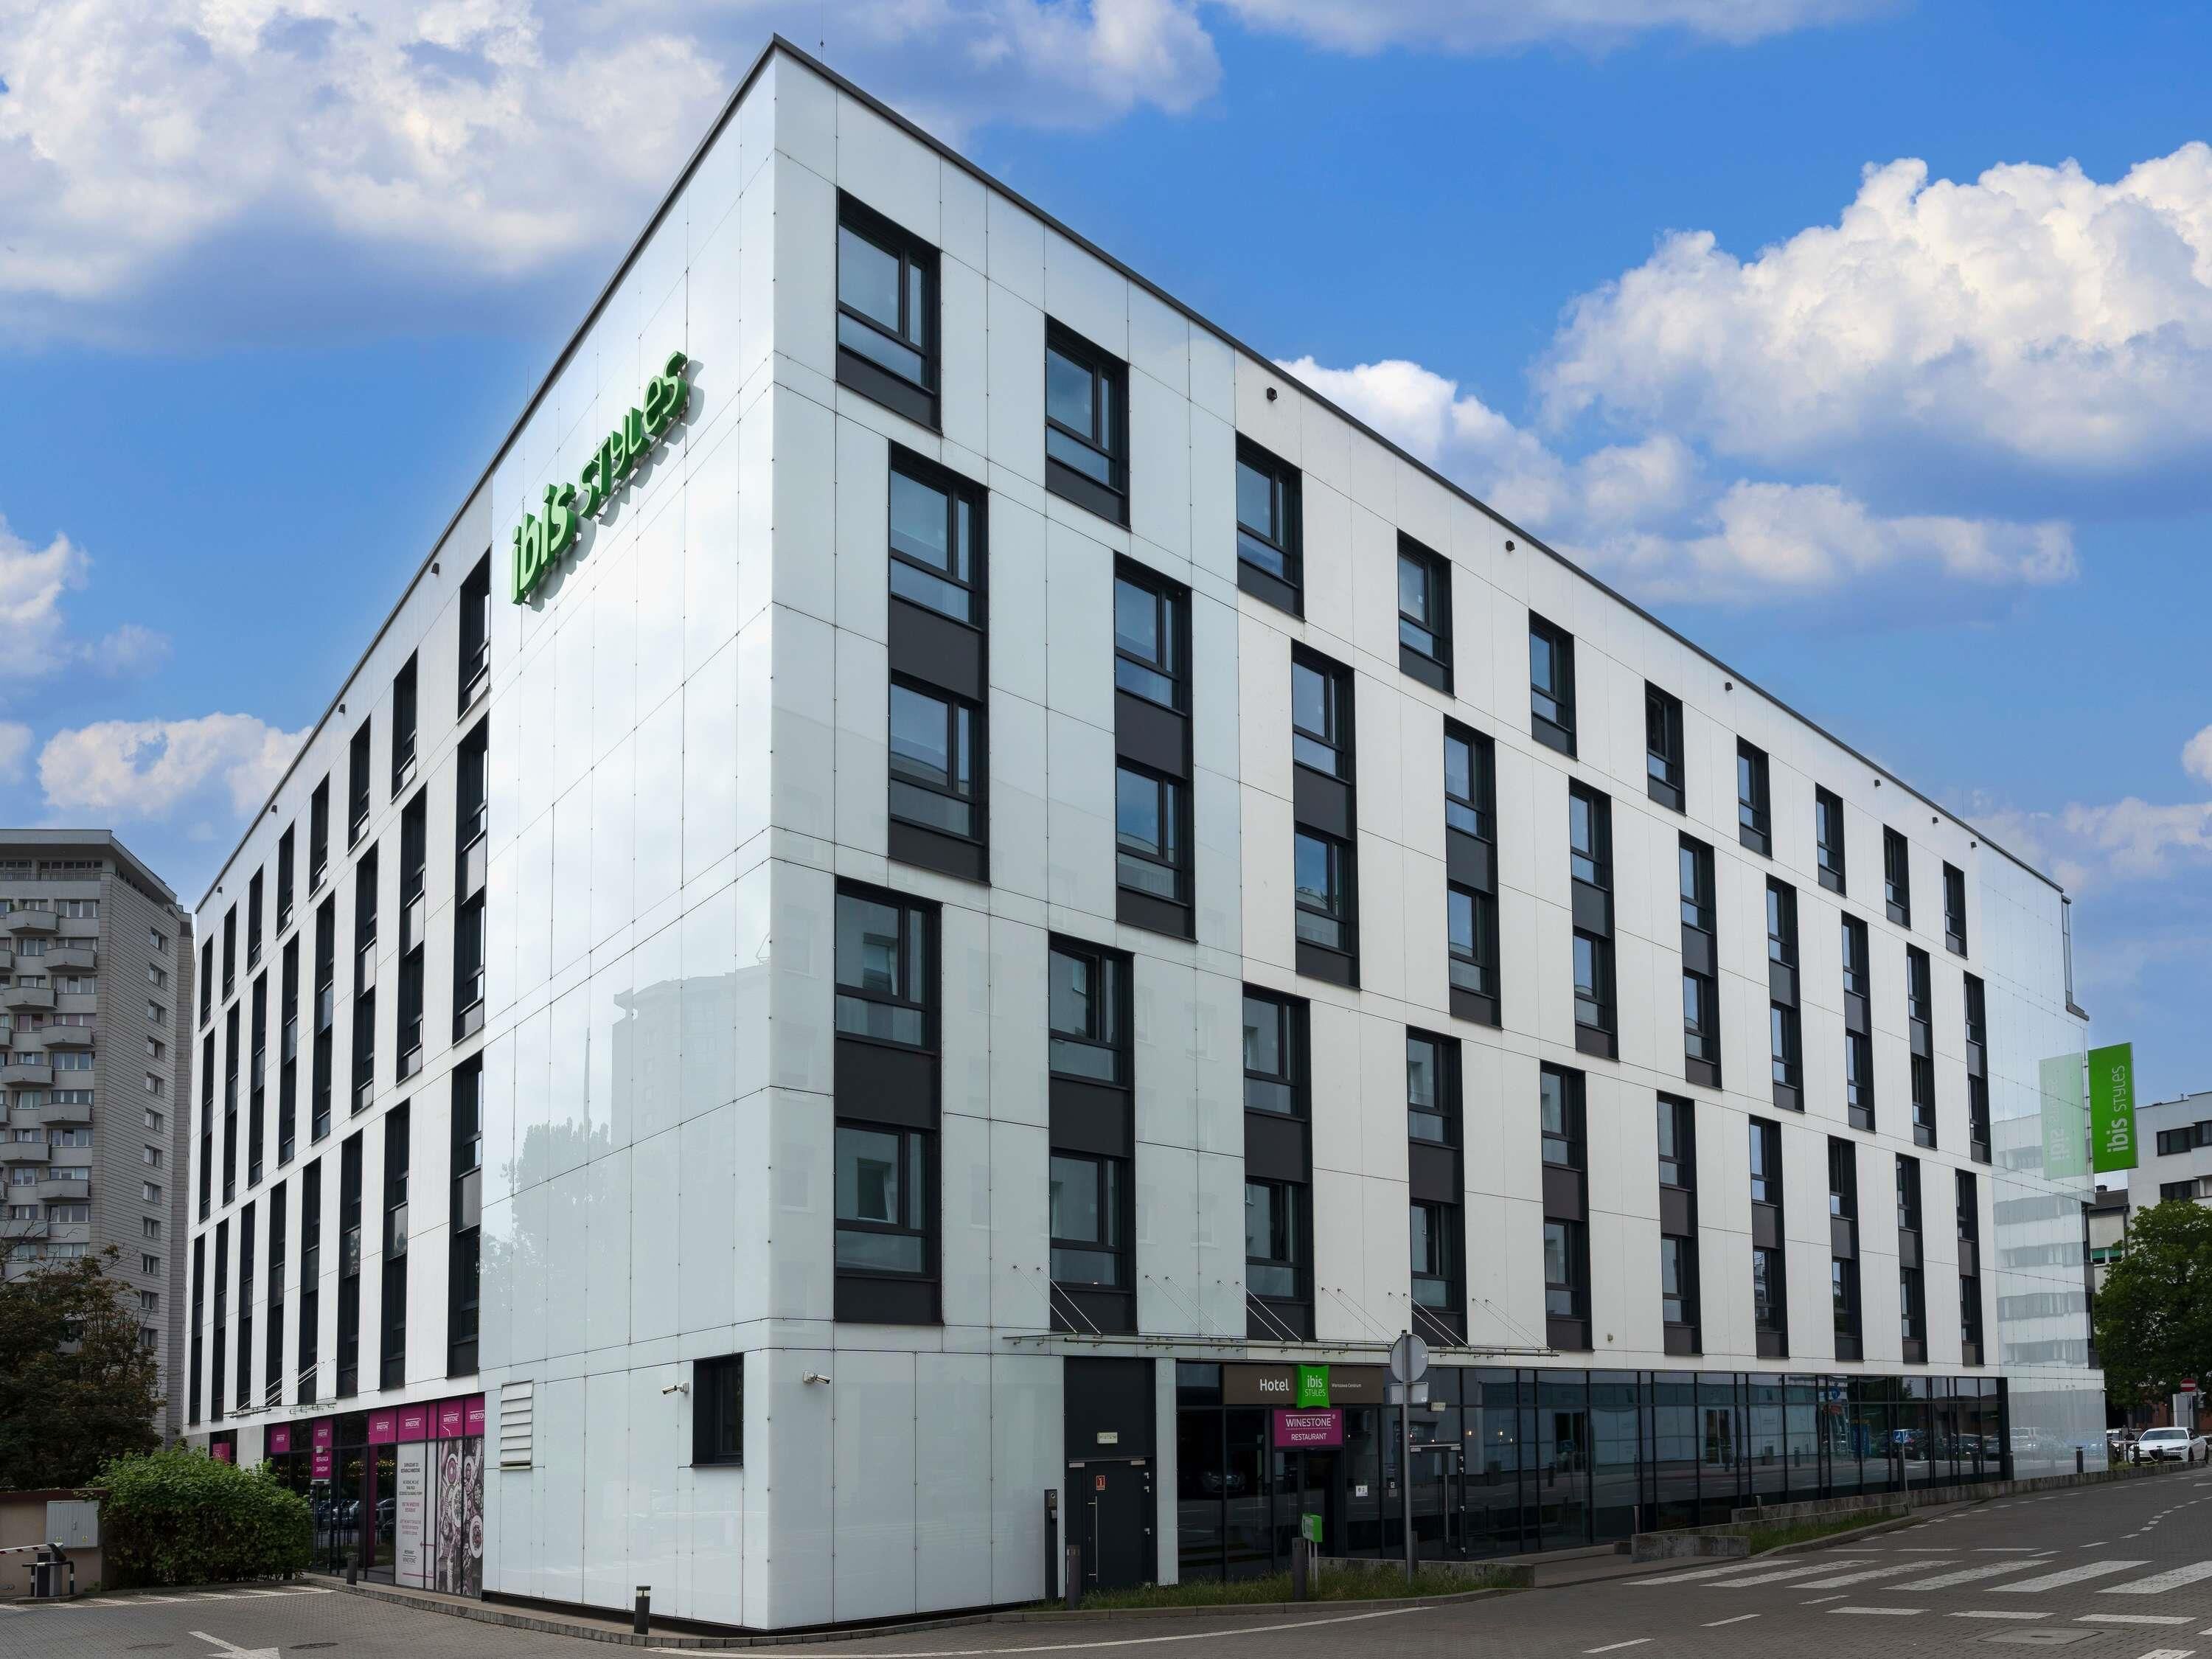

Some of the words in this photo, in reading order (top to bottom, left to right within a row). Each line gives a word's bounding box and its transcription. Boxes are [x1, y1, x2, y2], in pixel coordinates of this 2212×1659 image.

[512, 482, 577, 606] ibis
[2107, 1118, 2129, 1153] ibis
[1259, 1378, 1290, 1391] Hotel
[1307, 1374, 1323, 1388] ibis
[1286, 1417, 1332, 1427] WINESTONE
[1291, 1433, 1327, 1441] RESTAURANT
